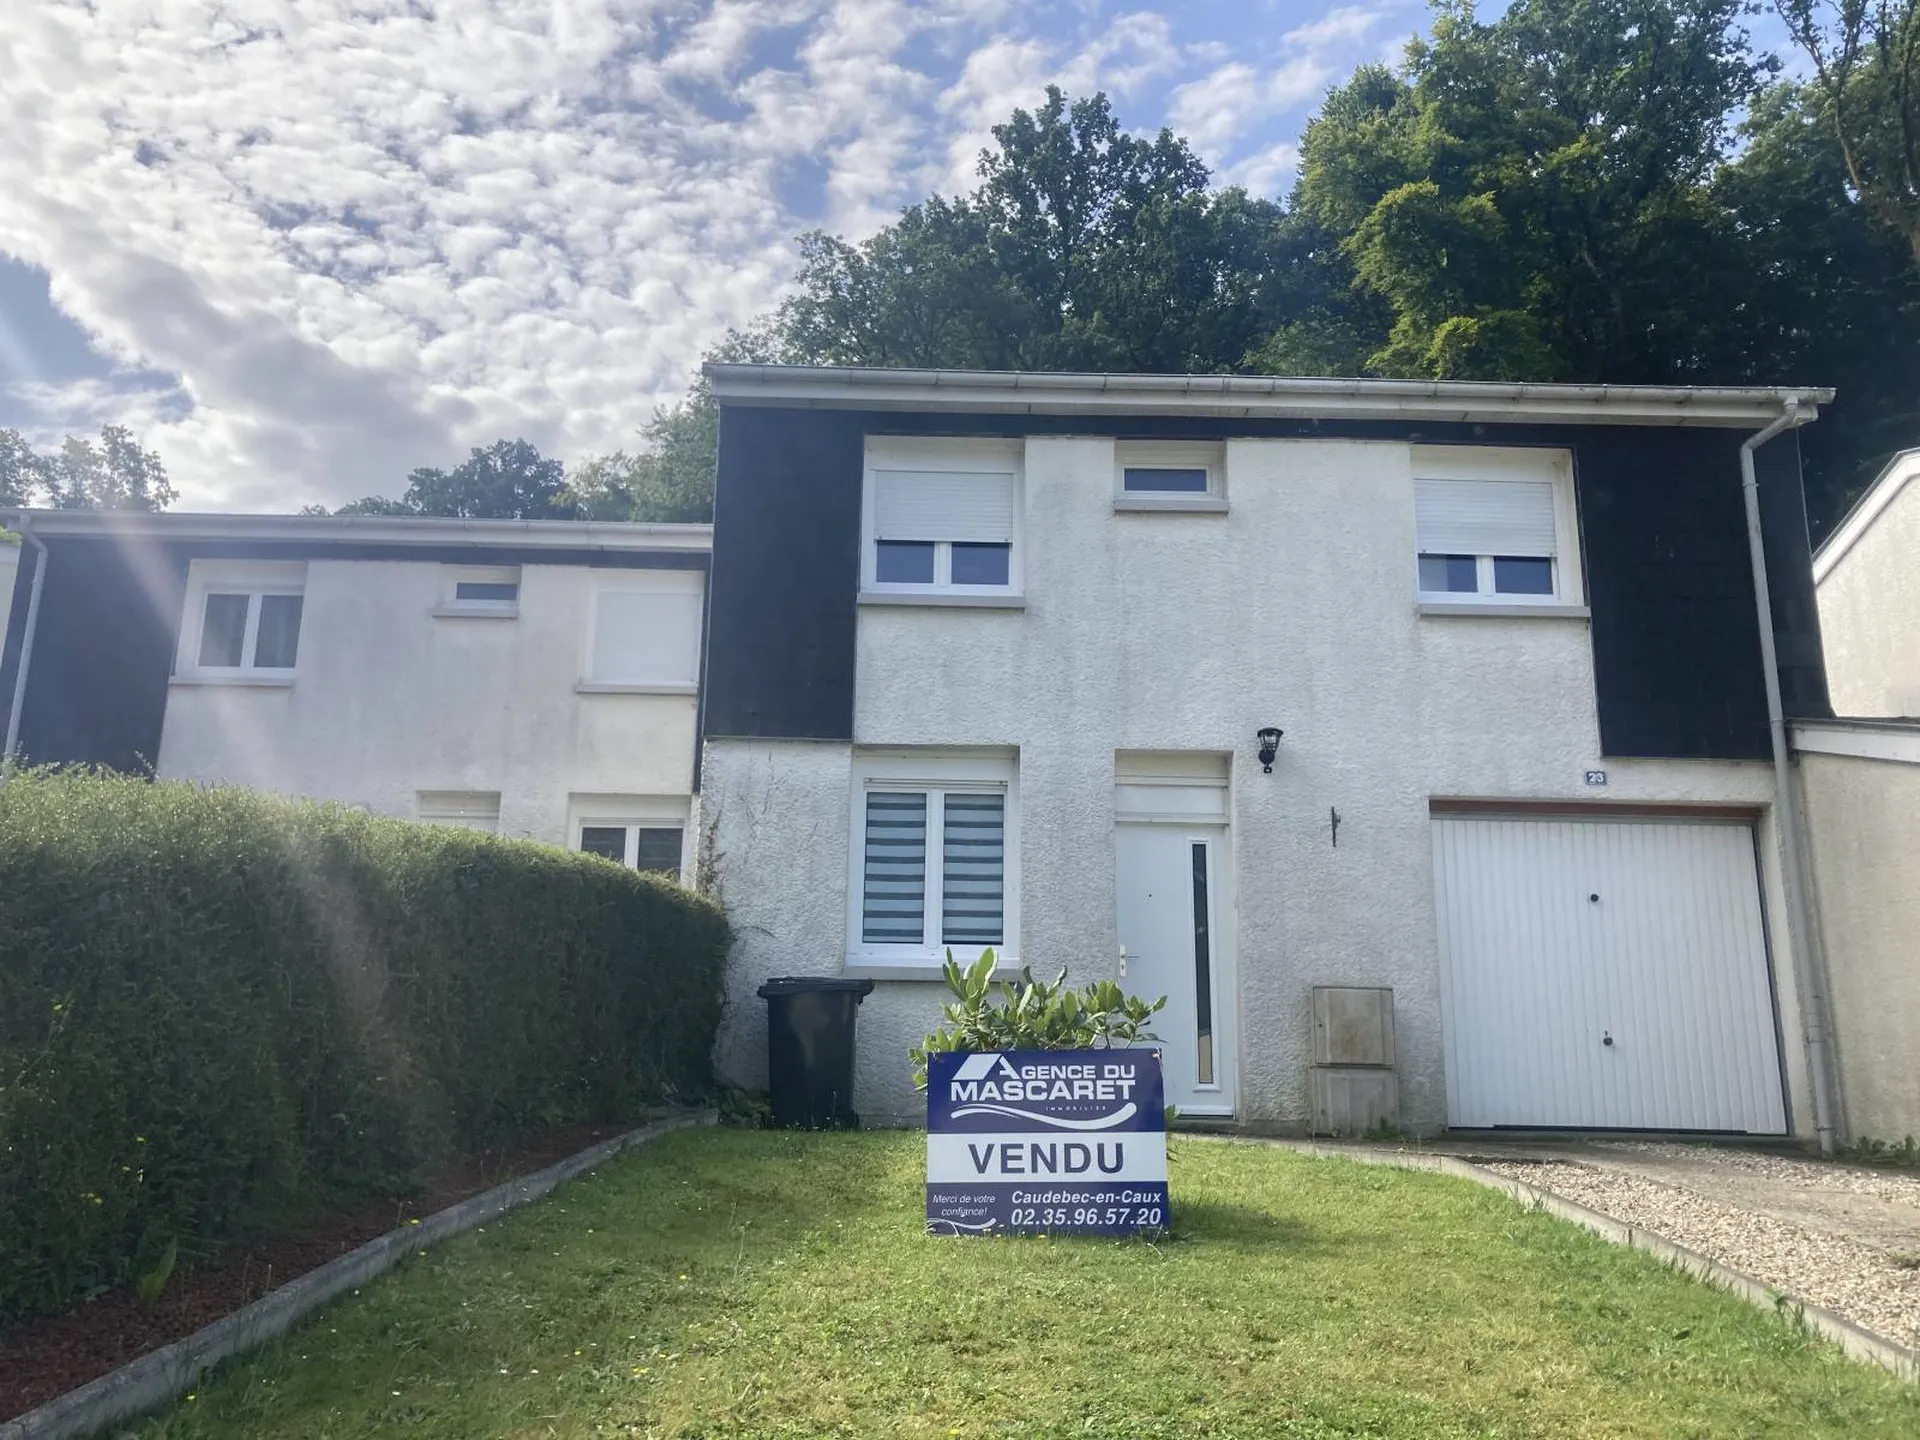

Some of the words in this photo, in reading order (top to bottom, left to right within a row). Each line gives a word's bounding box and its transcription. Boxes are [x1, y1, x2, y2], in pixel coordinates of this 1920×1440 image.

[1587, 772, 1605, 783] 23
[993, 1055, 1096, 1080] AGENCE
[1104, 1063, 1136, 1079] DU
[950, 1079, 1137, 1102] MASCARET
[967, 1142, 1125, 1175] VENDU
[932, 1193, 957, 1204] Merci
[959, 1193, 972, 1204] de
[973, 1194, 997, 1204] votre
[1010, 1189, 1162, 1205] Caudebec-en-Caux
[1010, 1207, 1162, 1227] 02.35.96.57.20
